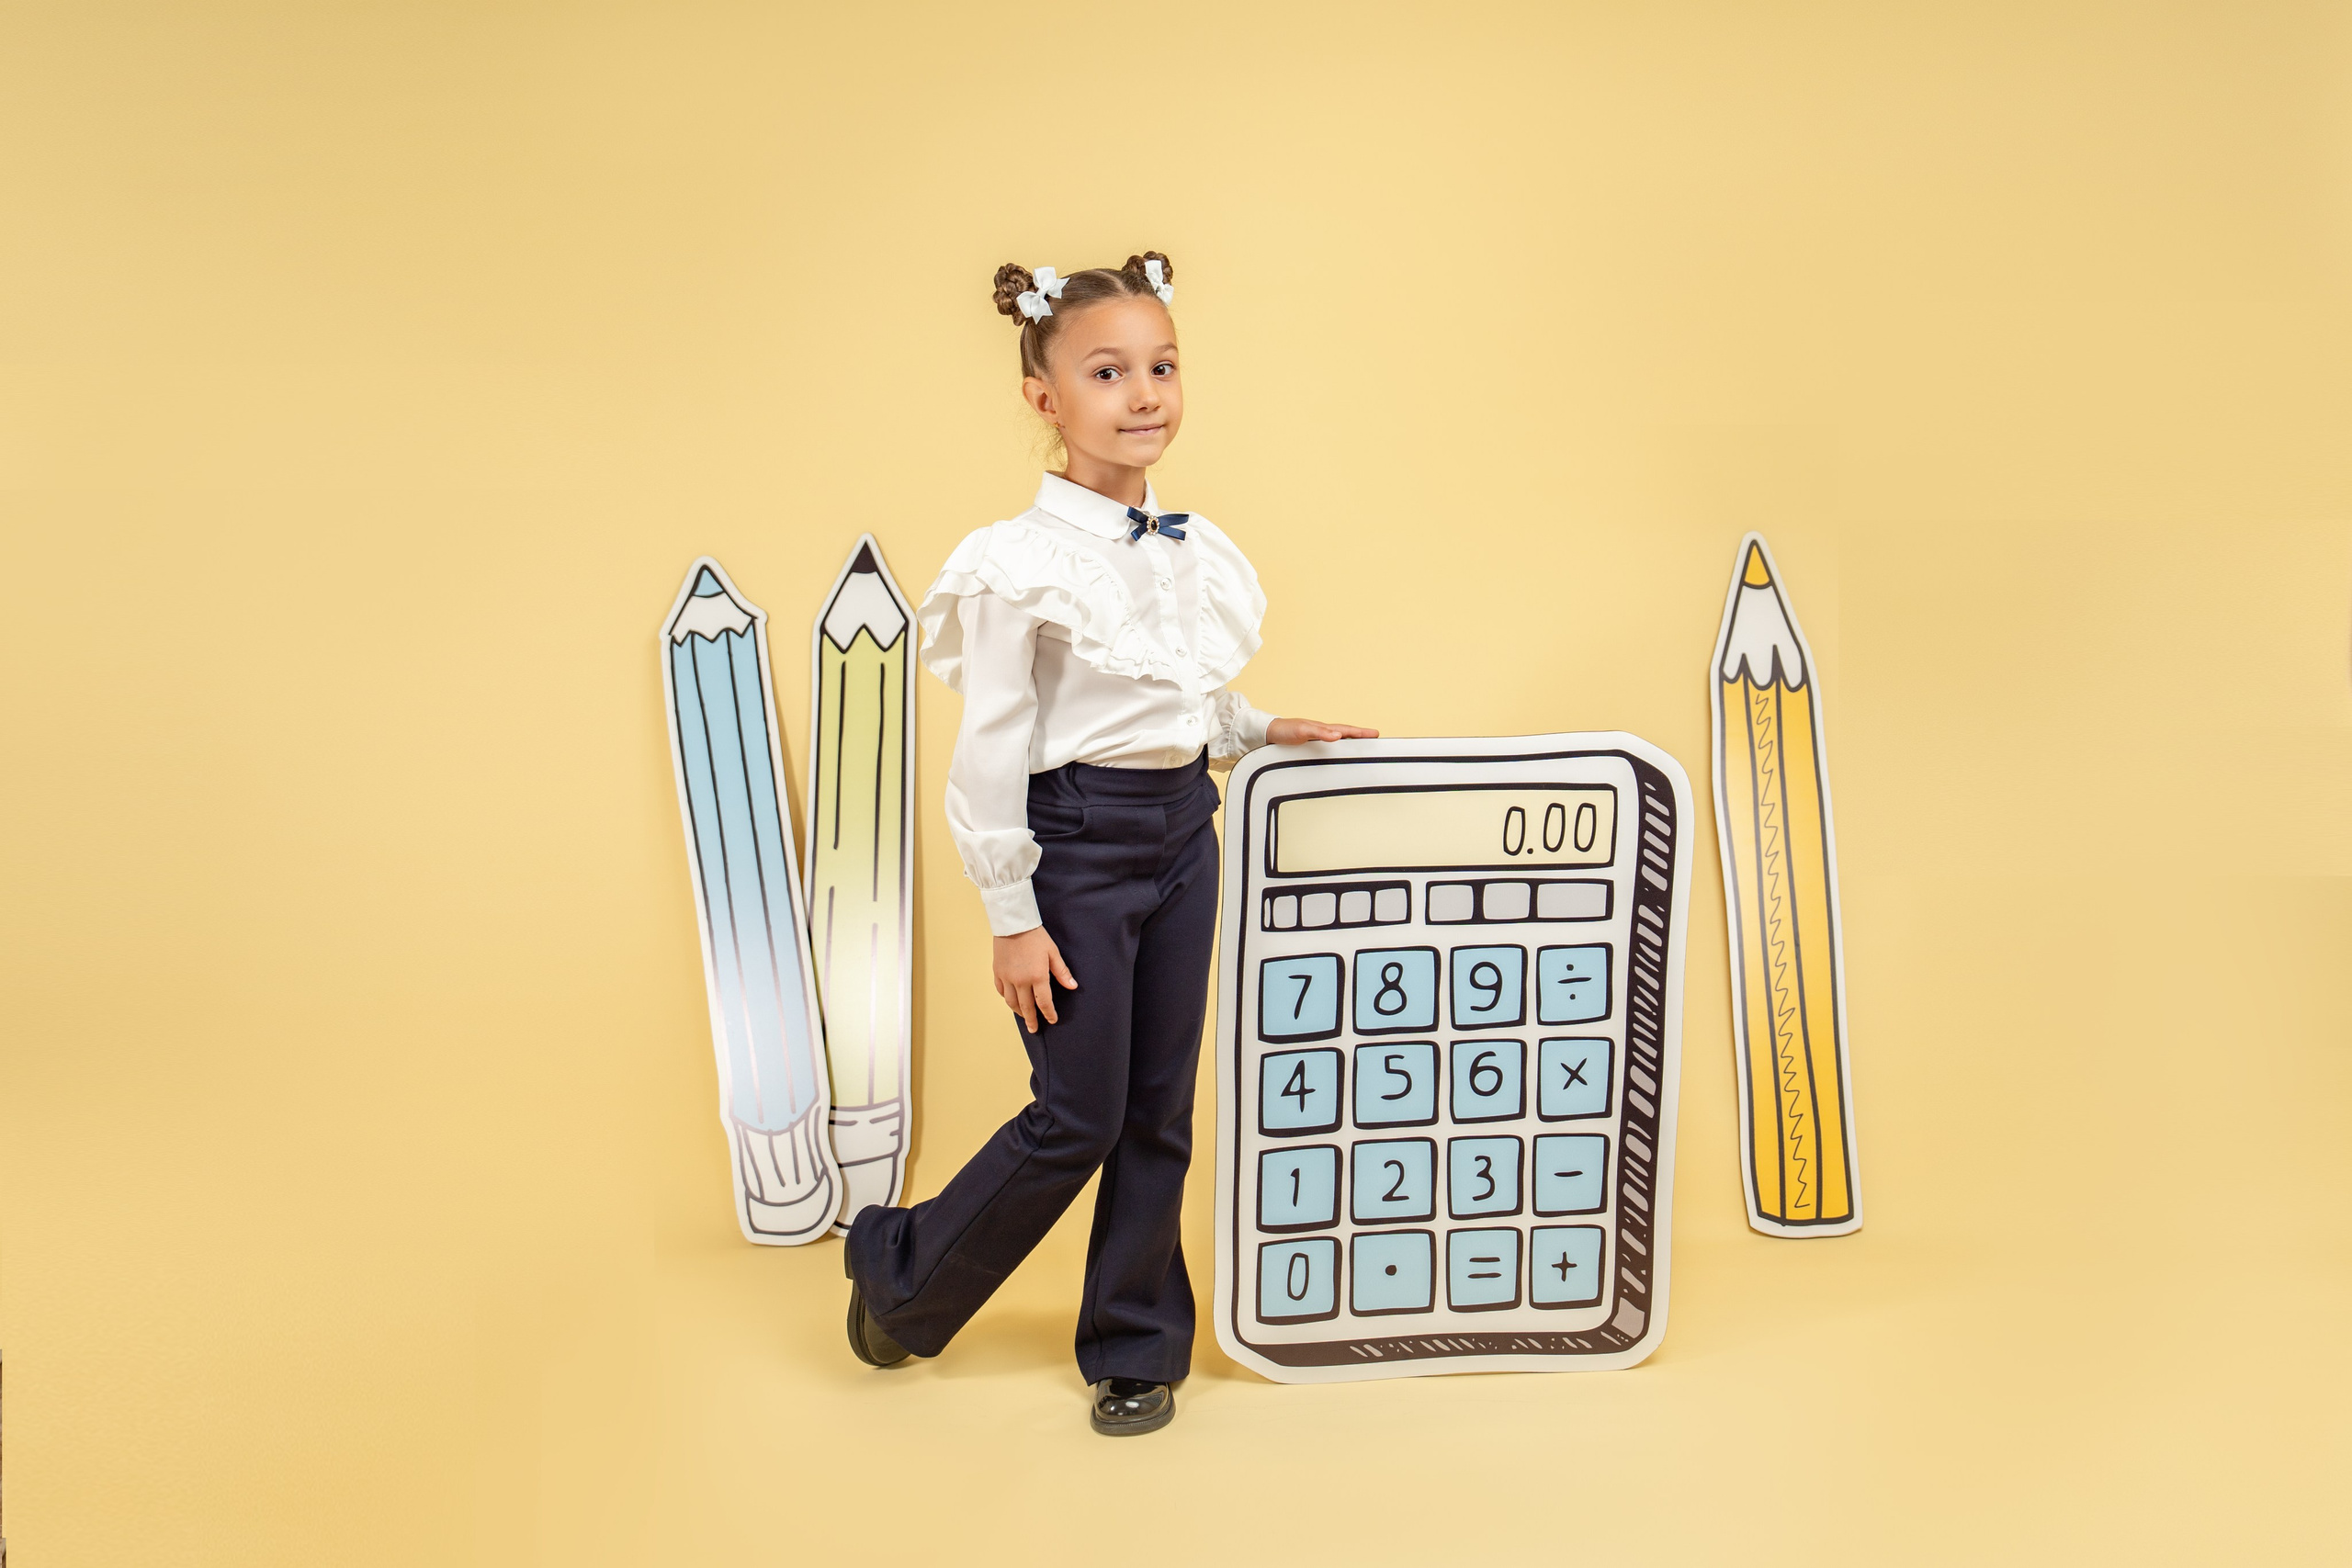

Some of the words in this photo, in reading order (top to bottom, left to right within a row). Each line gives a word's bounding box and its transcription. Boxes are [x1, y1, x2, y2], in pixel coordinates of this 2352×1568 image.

[1503, 802, 1597, 857] 0.00
[1287, 974, 1313, 1021] 7
[1373, 962, 1408, 1016] 8
[1469, 961, 1503, 1012] 9
[1280, 1059, 1317, 1113] 4
[1380, 1054, 1413, 1101] 5
[1468, 1050, 1504, 1097] 6
[1290, 1168, 1300, 1208] 1
[1381, 1159, 1410, 1202] 2
[1472, 1155, 1496, 1201] 3
[1286, 1252, 1310, 1302] 0
